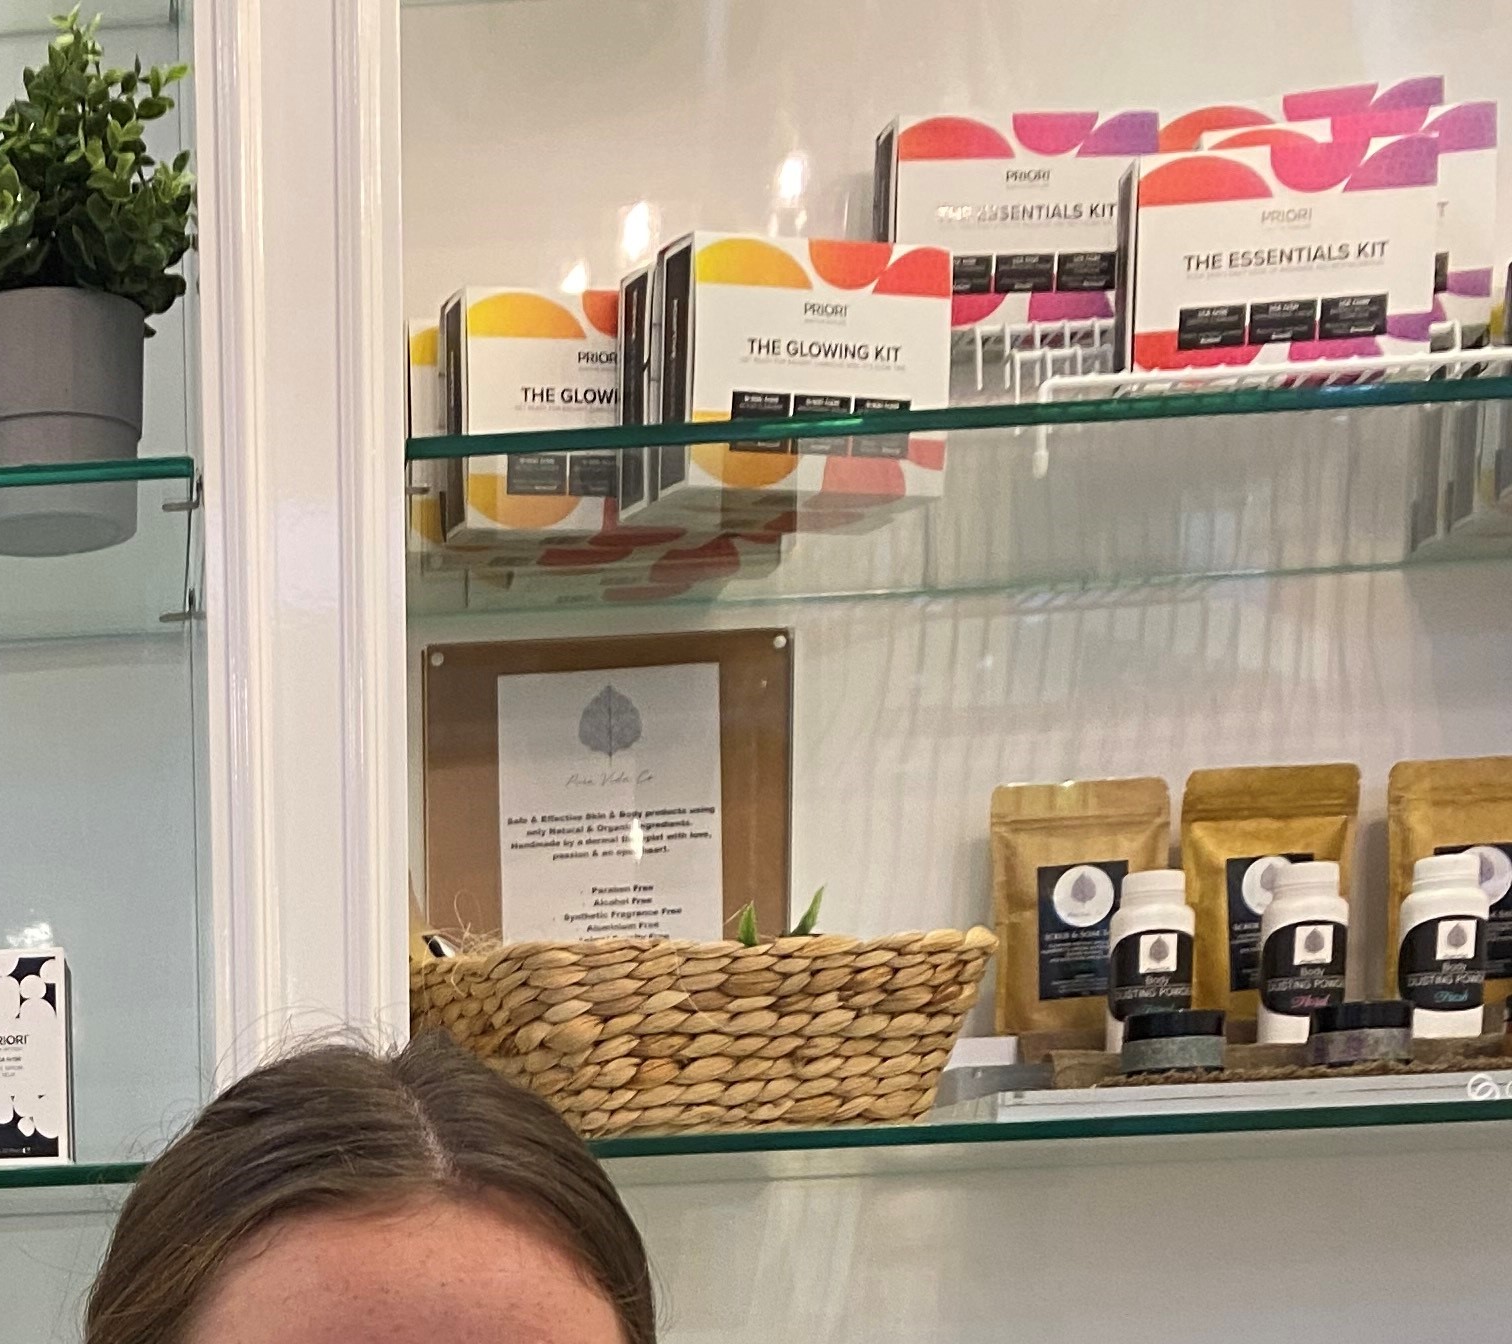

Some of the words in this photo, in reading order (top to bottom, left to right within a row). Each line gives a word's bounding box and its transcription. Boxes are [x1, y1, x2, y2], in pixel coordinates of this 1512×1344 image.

[1090, 203, 1117, 219] KIT
[1261, 208, 1312, 224] PRIORI
[1183, 253, 1223, 272] THE
[1228, 244, 1351, 269] ESSENTIALS
[1355, 240, 1389, 258] KIT
[804, 302, 848, 317] PRIORI
[747, 338, 781, 355] THE
[786, 341, 869, 361] GLOWING
[875, 346, 902, 362] KIT
[578, 351, 618, 364] PRIOR
[522, 387, 556, 403] THE
[561, 387, 618, 404] GLOWI
[508, 817, 528, 826] Safe
[541, 813, 583, 823] Effective
[585, 812, 606, 821] Skin
[619, 809, 643, 819] Body
[645, 807, 687, 818] products
[526, 828, 546, 838] only
[549, 826, 584, 835] Natural
[511, 839, 561, 849] Handmade
[563, 838, 575, 848] by
[585, 836, 619, 845] dermal
[666, 831, 687, 840] with
[592, 886, 630, 894] Paraben
[593, 898, 629, 906] Alcohol
[564, 912, 608, 922] Synthetic
[610, 910, 659, 919] Fragrance
[638, 921, 659, 929] Free
[1300, 966, 1325, 977] Body
[1145, 975, 1170, 986] Body
[1268, 978, 1312, 991] DUSTING
[1407, 974, 1454, 987] DUSTING
